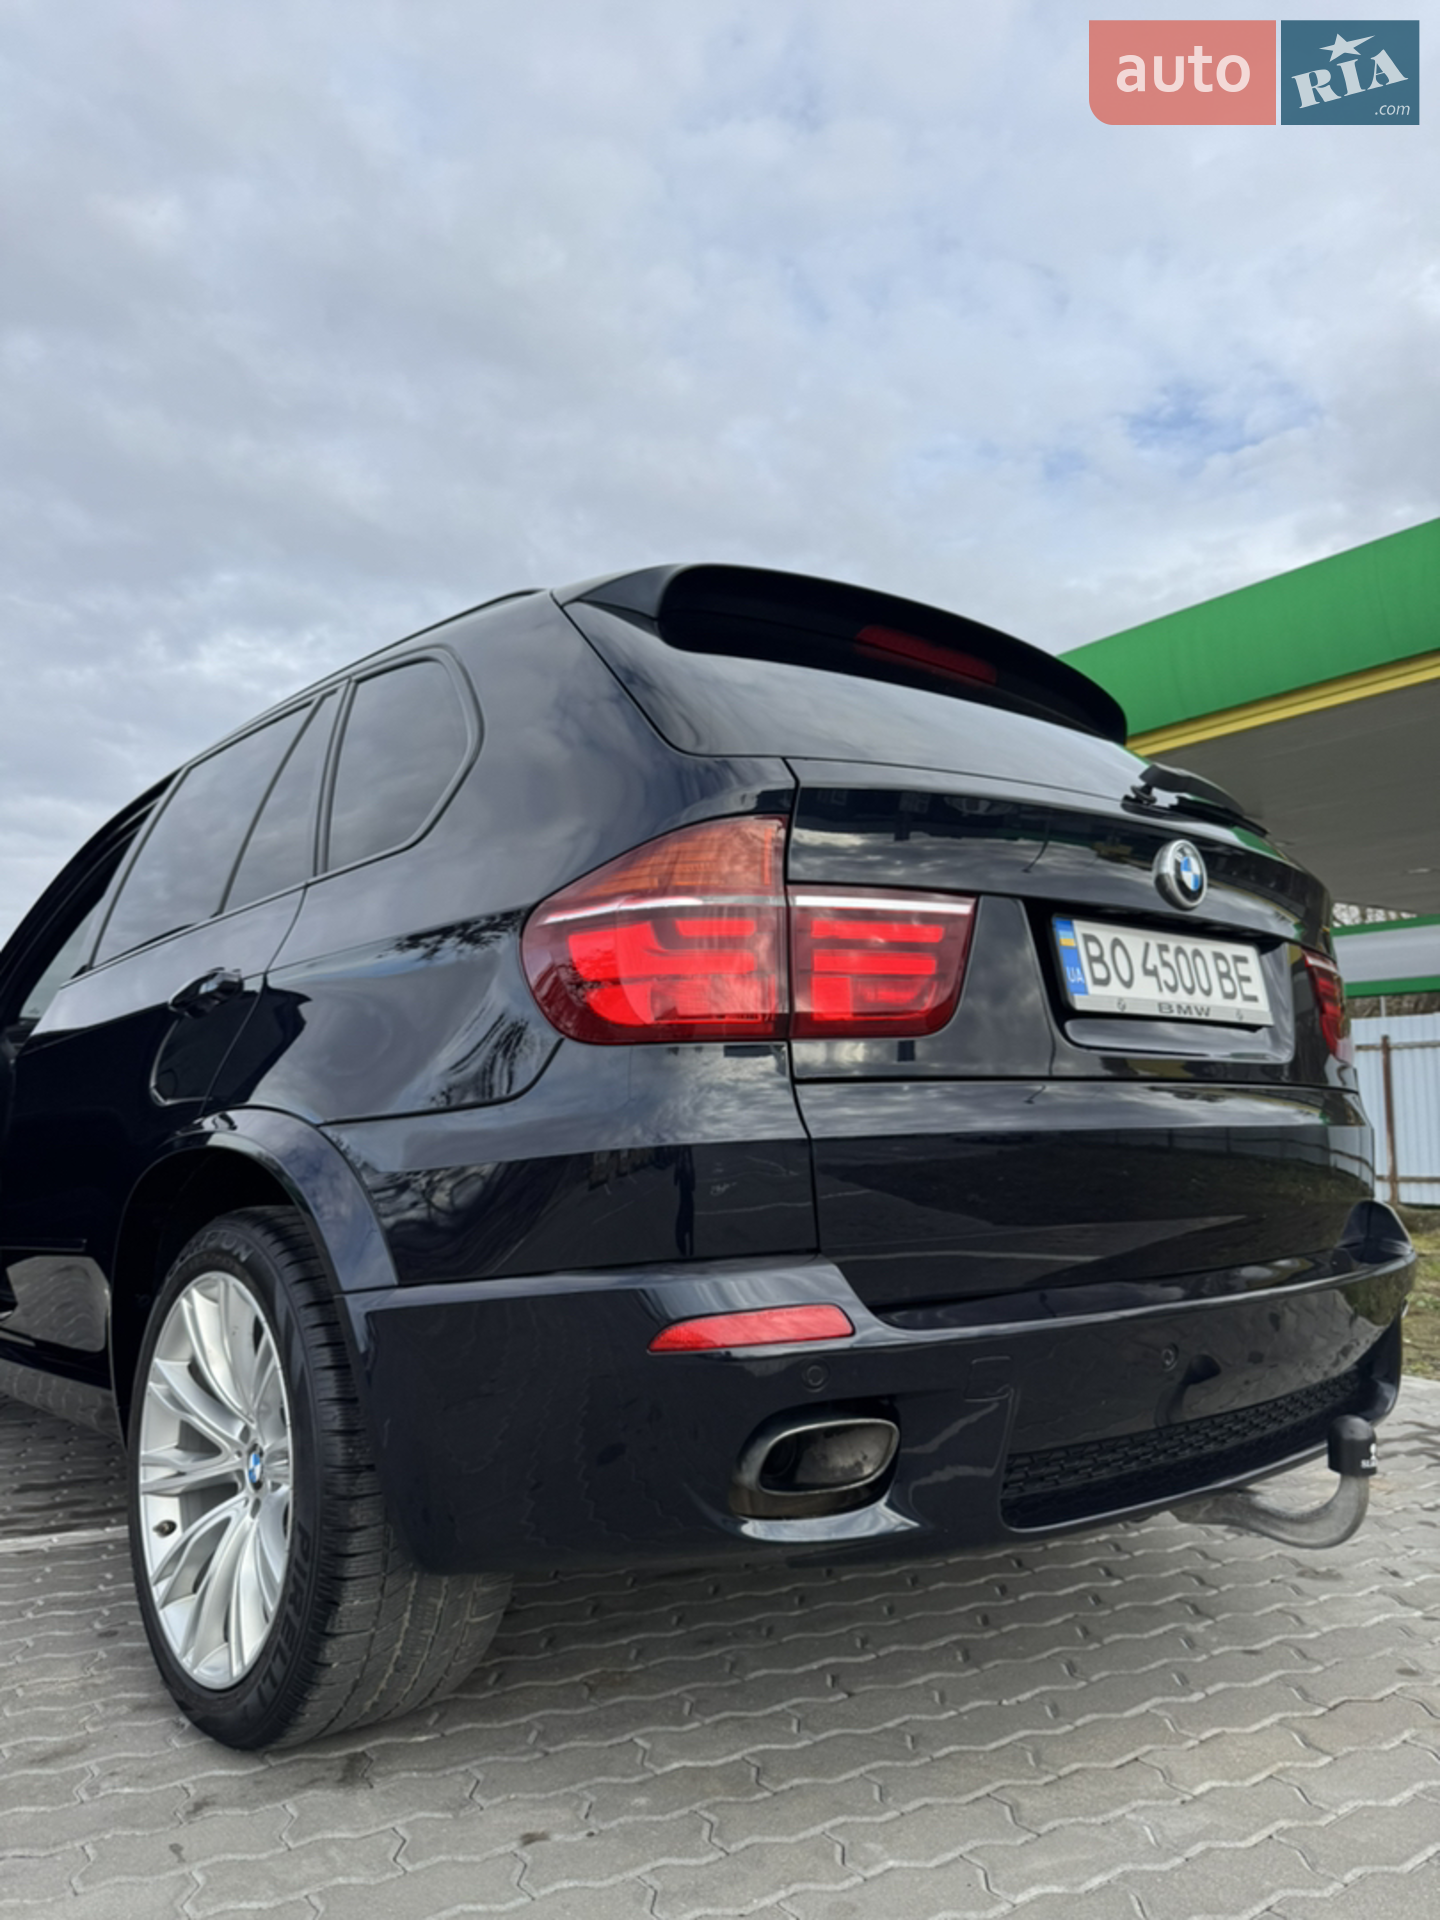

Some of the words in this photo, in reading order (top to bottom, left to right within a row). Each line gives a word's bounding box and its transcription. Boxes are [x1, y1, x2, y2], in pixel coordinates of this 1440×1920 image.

[1066, 966, 1085, 983] UA
[1081, 932, 1134, 989] BO
[1142, 941, 1212, 997] 4500
[1212, 951, 1259, 1003] BE
[1158, 1002, 1211, 1017] BMW
[257, 1520, 312, 1708] PIRELLI
